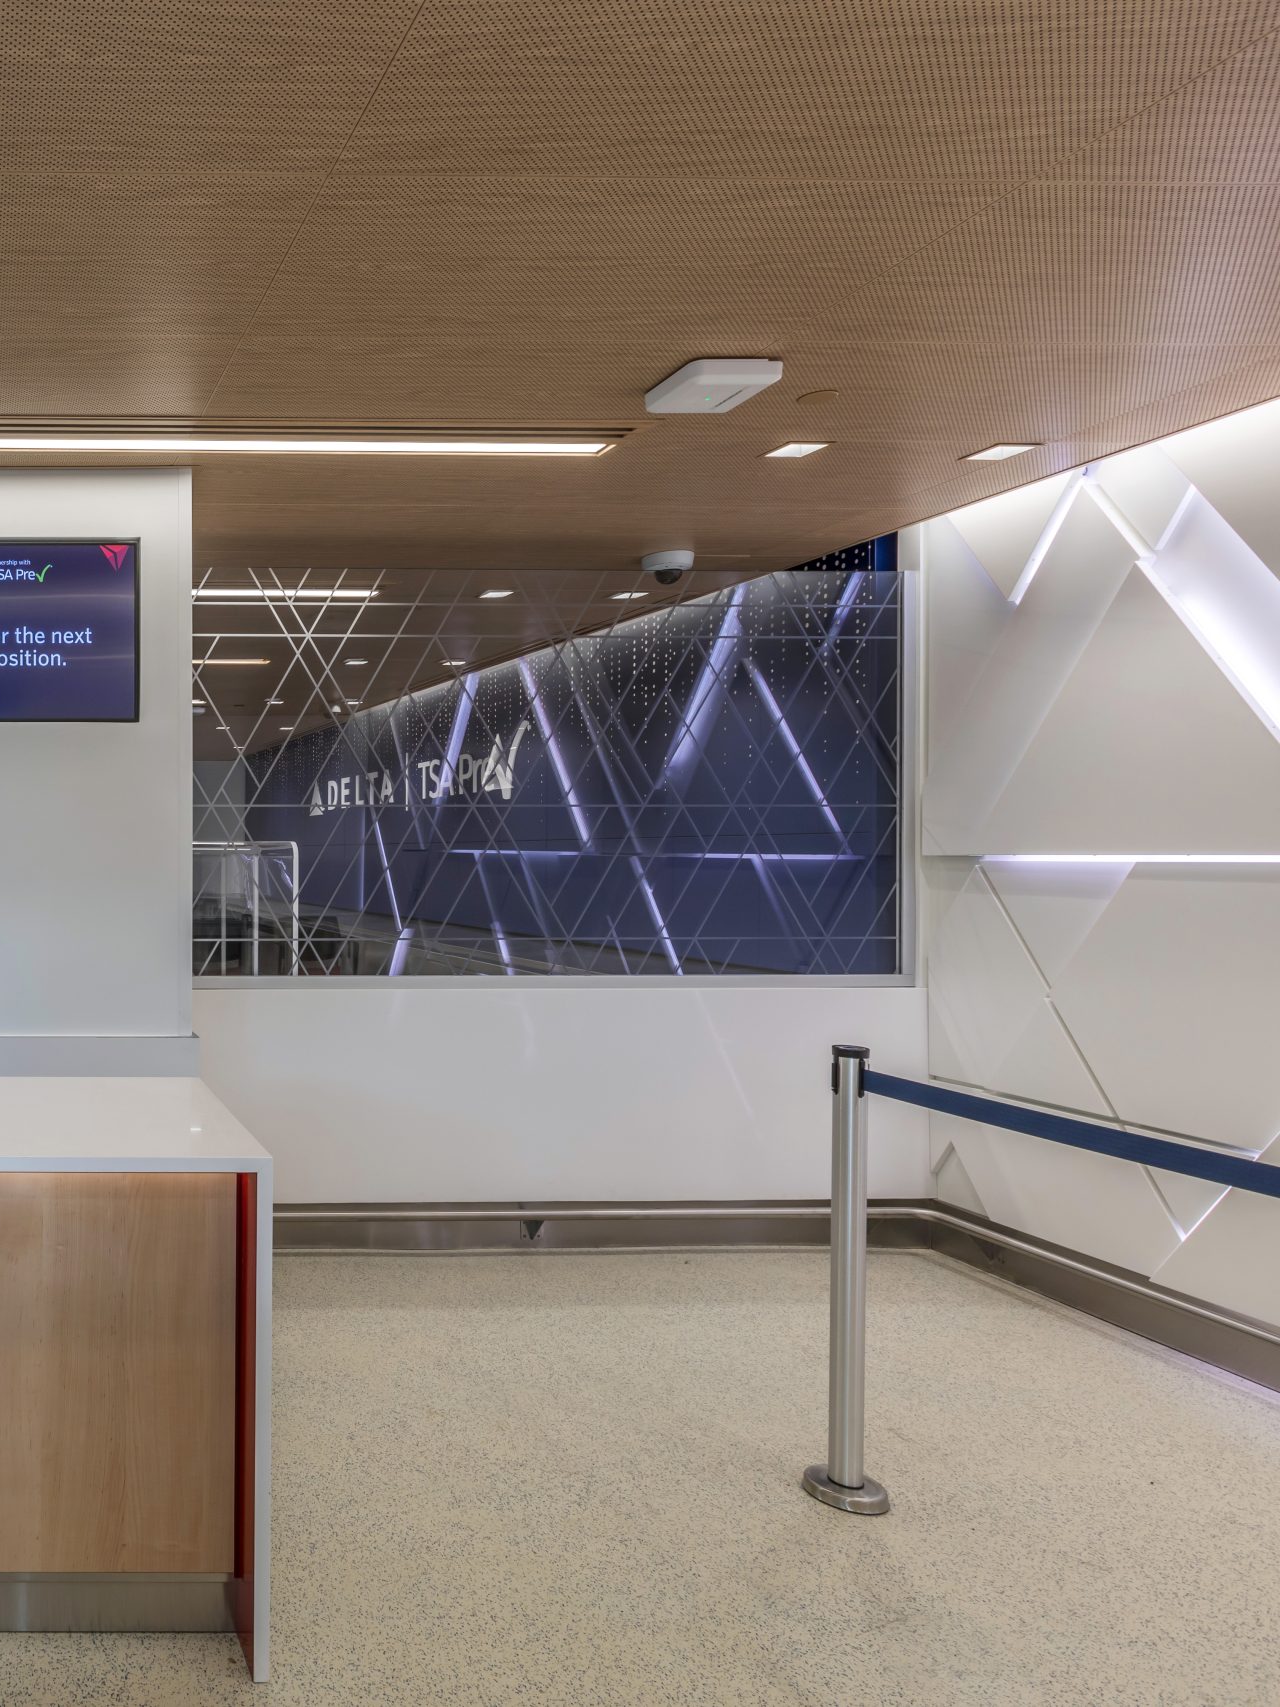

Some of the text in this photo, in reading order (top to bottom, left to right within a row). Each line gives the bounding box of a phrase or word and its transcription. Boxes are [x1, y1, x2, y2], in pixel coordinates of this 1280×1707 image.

[16, 569, 36, 580] Pre
[15, 627, 46, 644] the
[51, 628, 93, 644] next
[327, 769, 394, 811] DELTA
[418, 758, 455, 800] TSA
